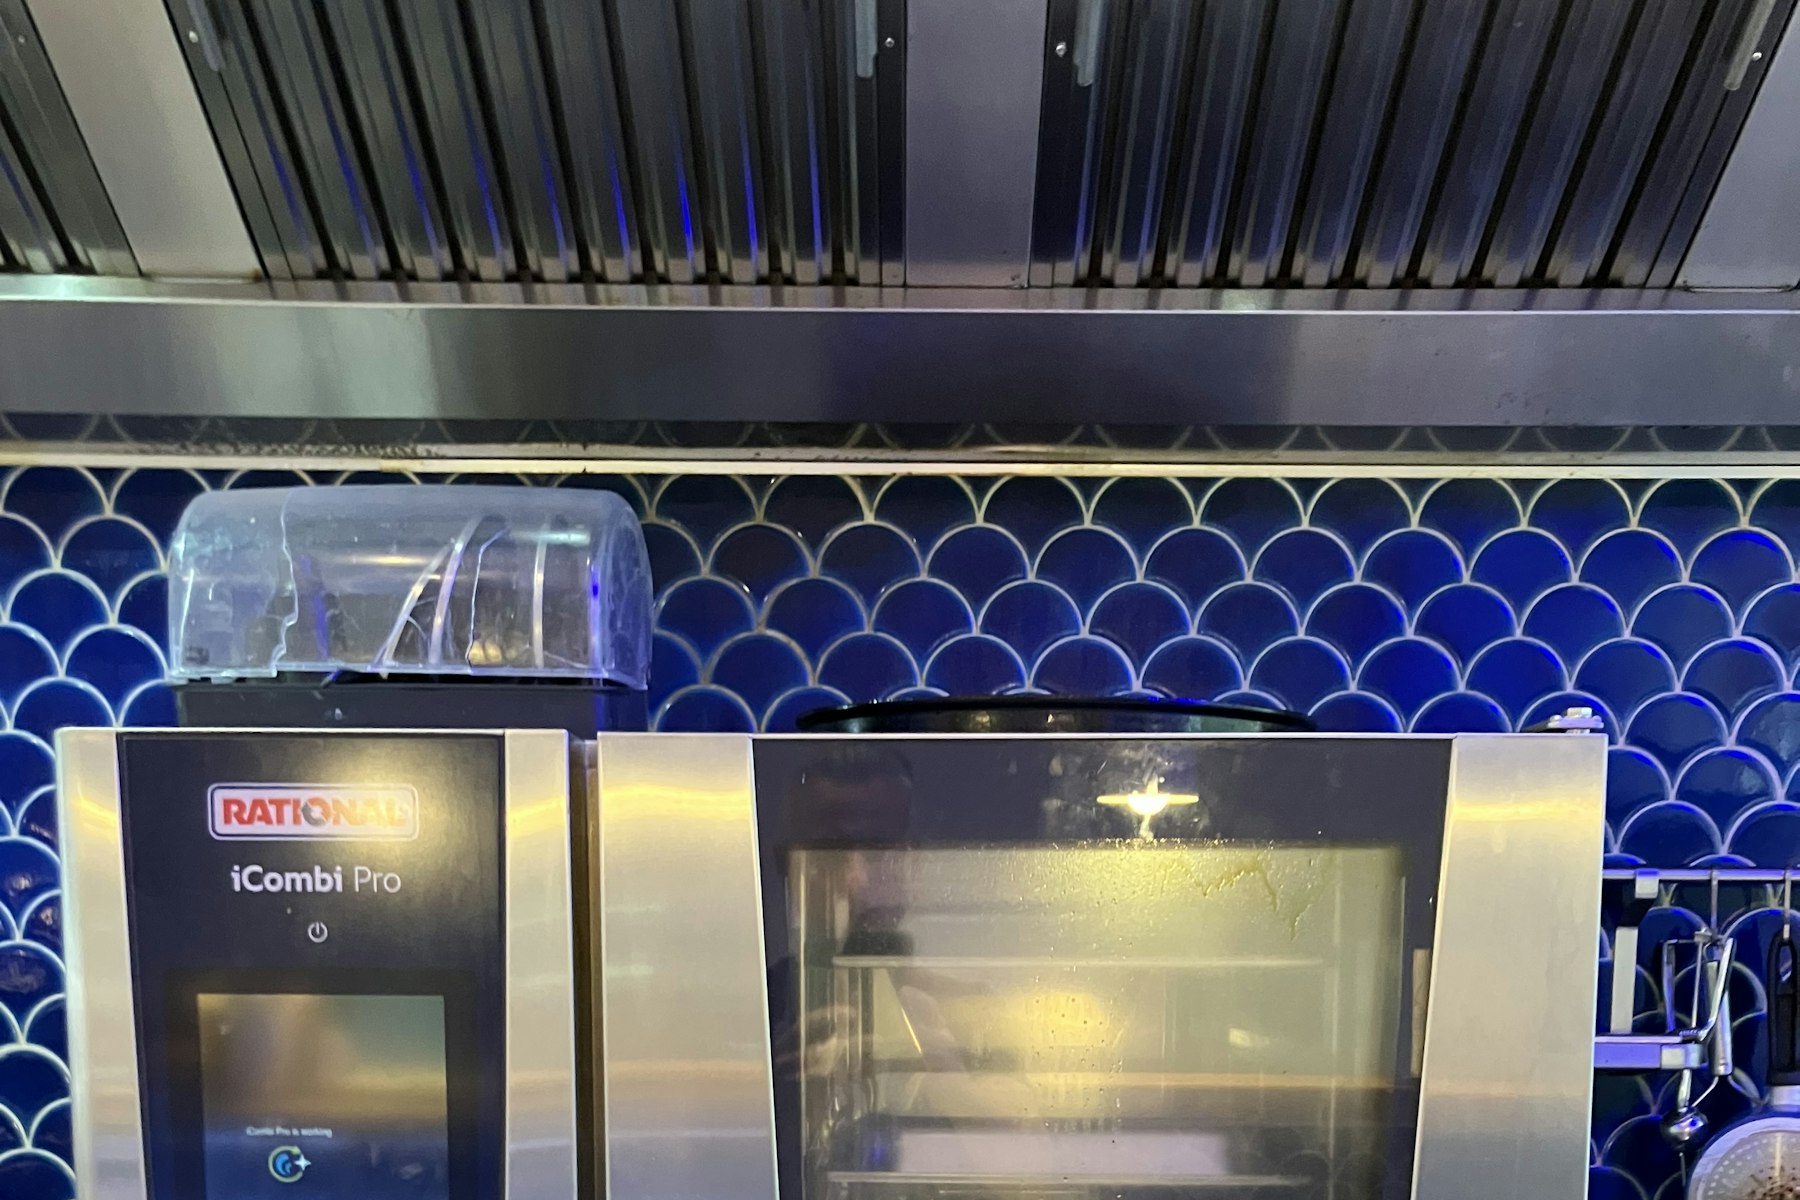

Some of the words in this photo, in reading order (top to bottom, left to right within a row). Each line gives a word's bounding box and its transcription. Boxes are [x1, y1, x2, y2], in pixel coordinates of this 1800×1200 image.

[222, 797, 406, 826] RATIONAL
[231, 864, 343, 893] iCombi
[354, 865, 402, 893] Pro
